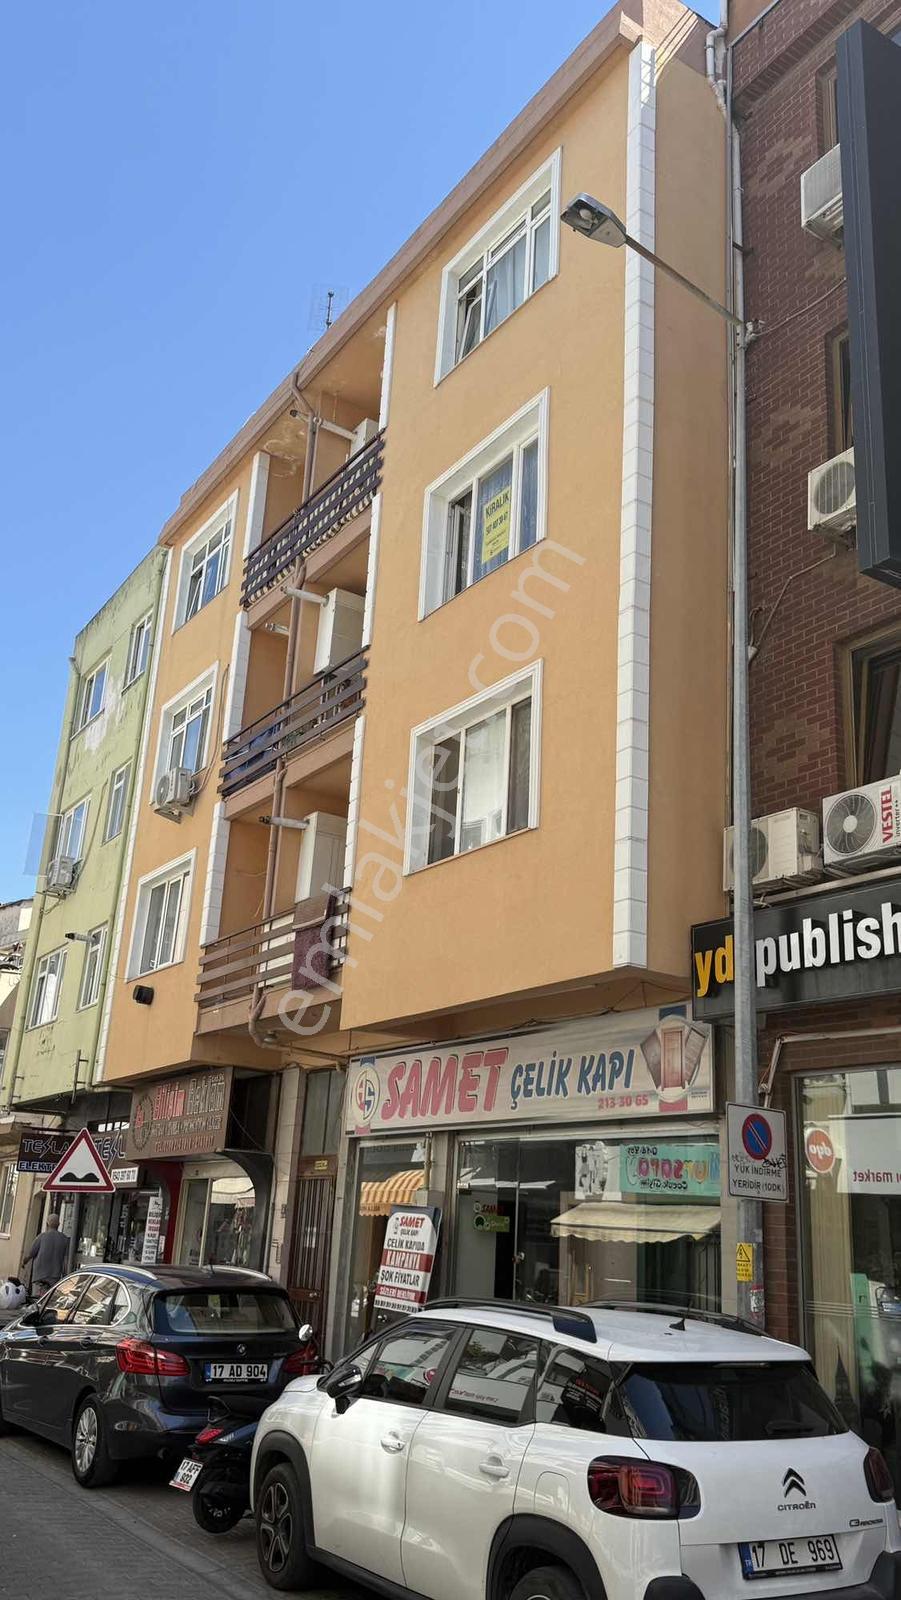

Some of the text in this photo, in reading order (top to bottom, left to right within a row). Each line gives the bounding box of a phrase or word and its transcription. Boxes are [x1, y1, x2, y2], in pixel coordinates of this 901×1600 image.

[881, 785, 893, 843] VESTEL
[695, 935, 735, 998] yd
[381, 1047, 635, 1120] SAMET ÇELİK KAPI
[399, 1215, 426, 1229] SAMET
[385, 1251, 421, 1270] KAMPANYA
[213, 1365, 266, 1377] 17 AD 904
[752, 1539, 835, 1568] 17 DE 969
